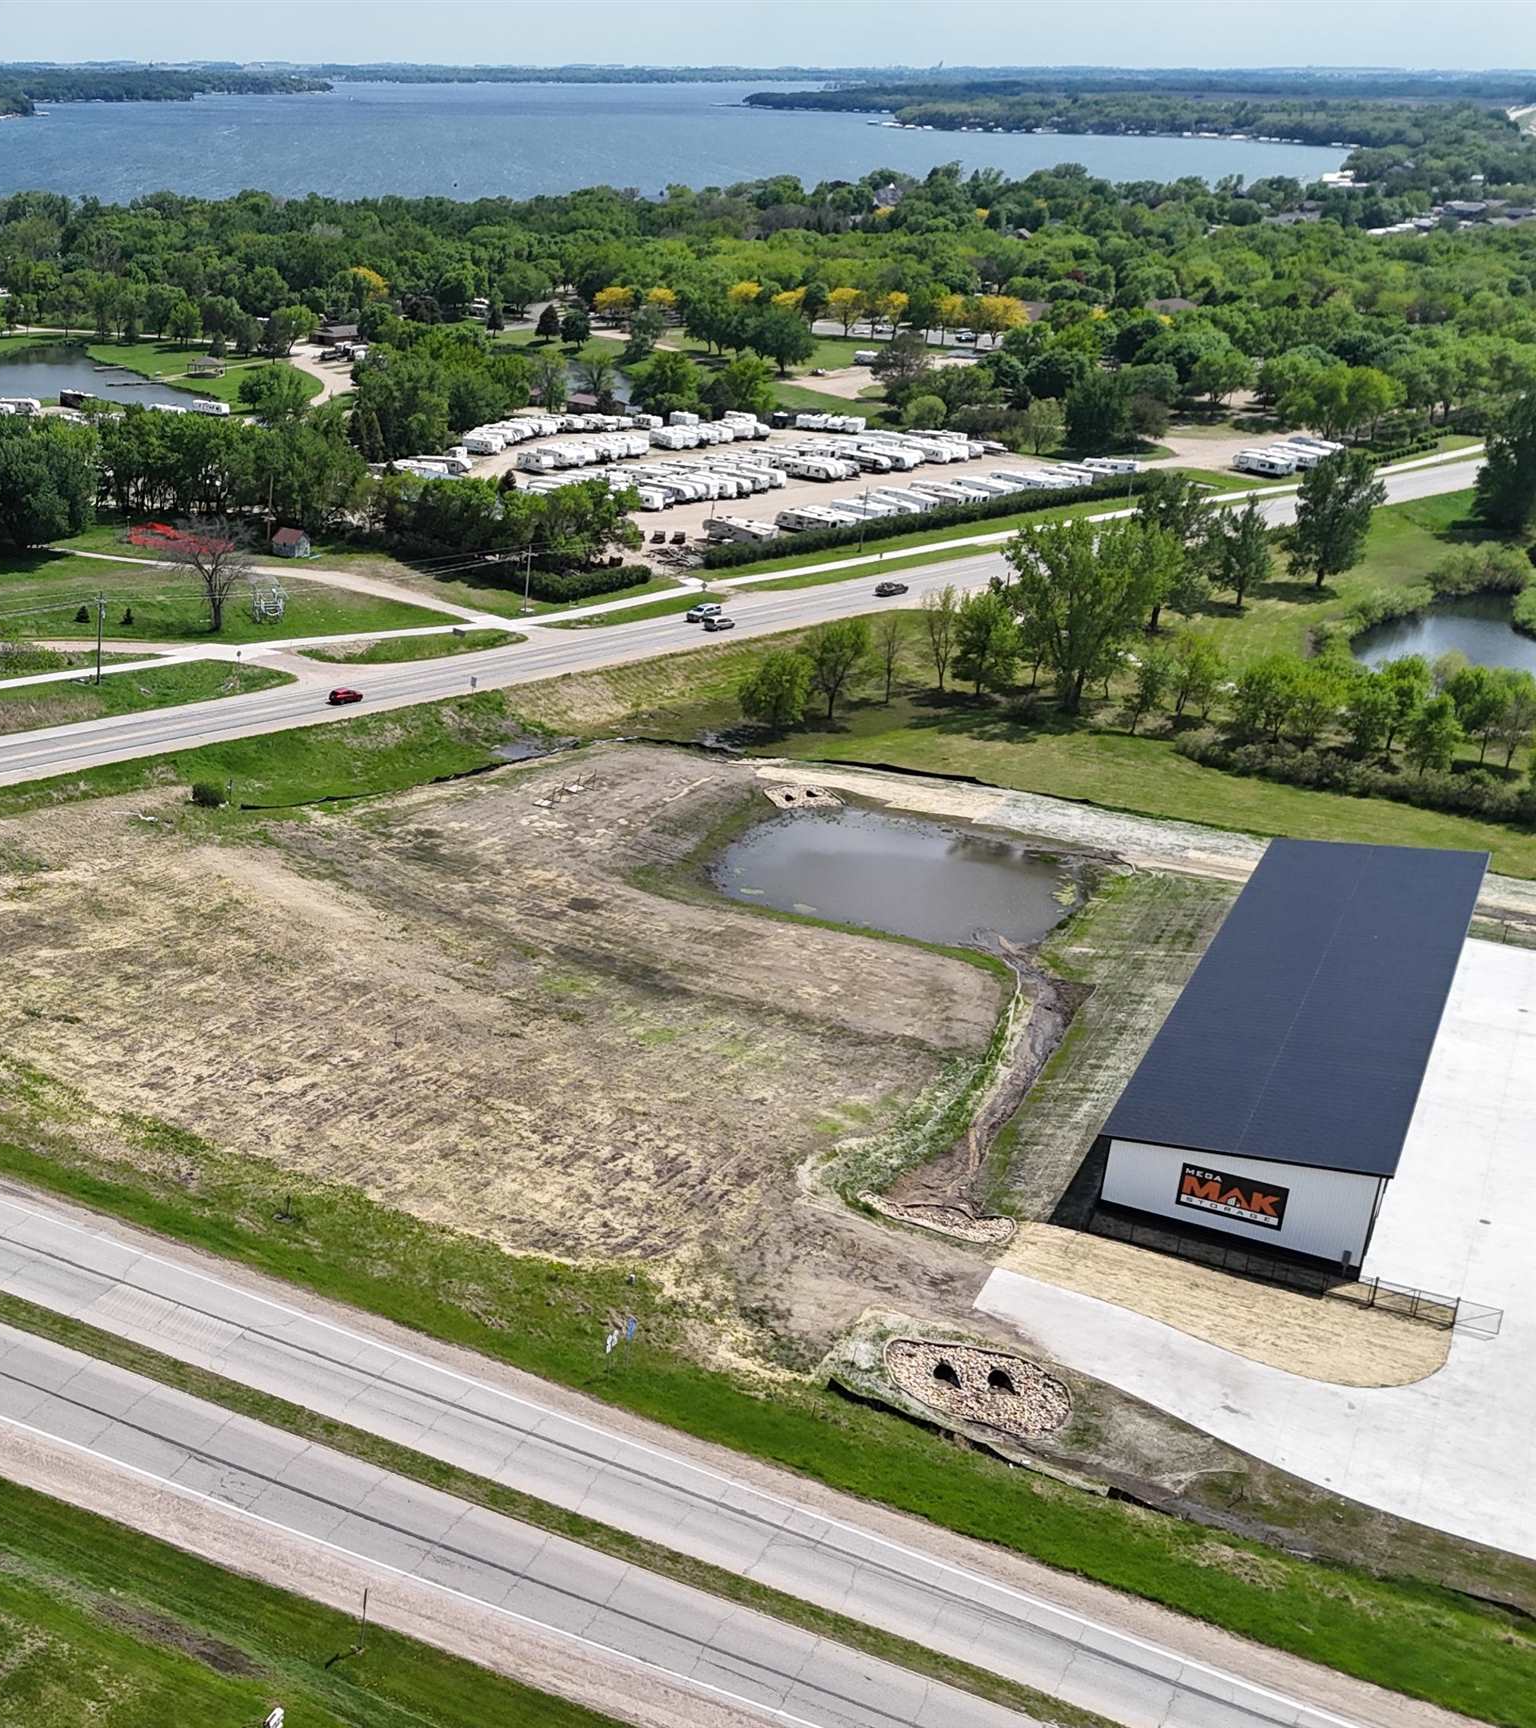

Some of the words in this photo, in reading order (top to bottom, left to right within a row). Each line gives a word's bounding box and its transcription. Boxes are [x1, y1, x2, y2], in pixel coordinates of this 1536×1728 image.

[1185, 1168, 1223, 1183] MEGA
[1182, 1175, 1281, 1217] MAK
[1185, 1196, 1271, 1223] STORAGE
